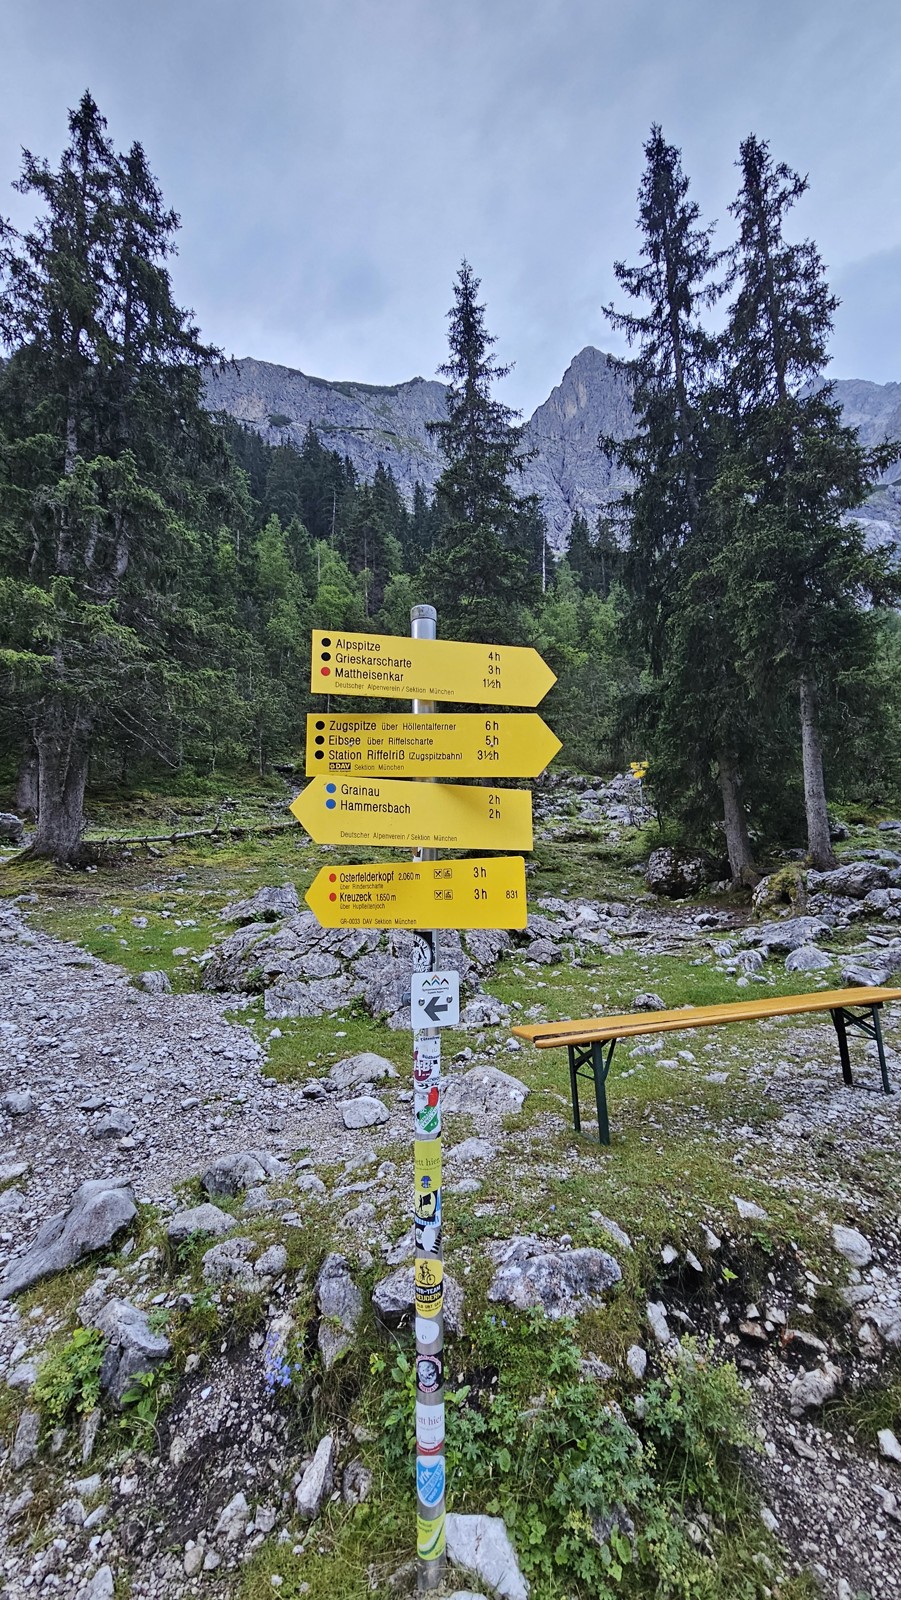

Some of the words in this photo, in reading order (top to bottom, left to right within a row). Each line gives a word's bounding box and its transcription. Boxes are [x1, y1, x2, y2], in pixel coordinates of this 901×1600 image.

[335, 639, 381, 652] Alpspitze
[335, 654, 412, 668] Grieskarscharte
[335, 667, 404, 682] Mattheisenkar
[335, 681, 364, 689] Deutscher
[367, 684, 400, 692] Alpenverein
[429, 688, 455, 696] München
[329, 721, 377, 732] Zugspitze
[381, 723, 398, 731] über
[402, 722, 456, 731] Höllentalferner
[328, 735, 361, 746] Eibsee
[367, 737, 384, 745] über
[388, 737, 434, 746] Riffelscharte
[328, 750, 362, 760] Station
[367, 750, 405, 760] Riffelriß
[408, 752, 463, 761] (Zugspitzbahn)
[341, 784, 380, 797] Grainau
[340, 800, 411, 814] Hammersbach
[340, 831, 370, 839] Deutscher
[372, 832, 406, 841] Alpenverein
[433, 834, 458, 842] München
[339, 871, 395, 883] Osterfelderkopf
[339, 891, 372, 902] Kreuzeck
[505, 890, 518, 899] 831
